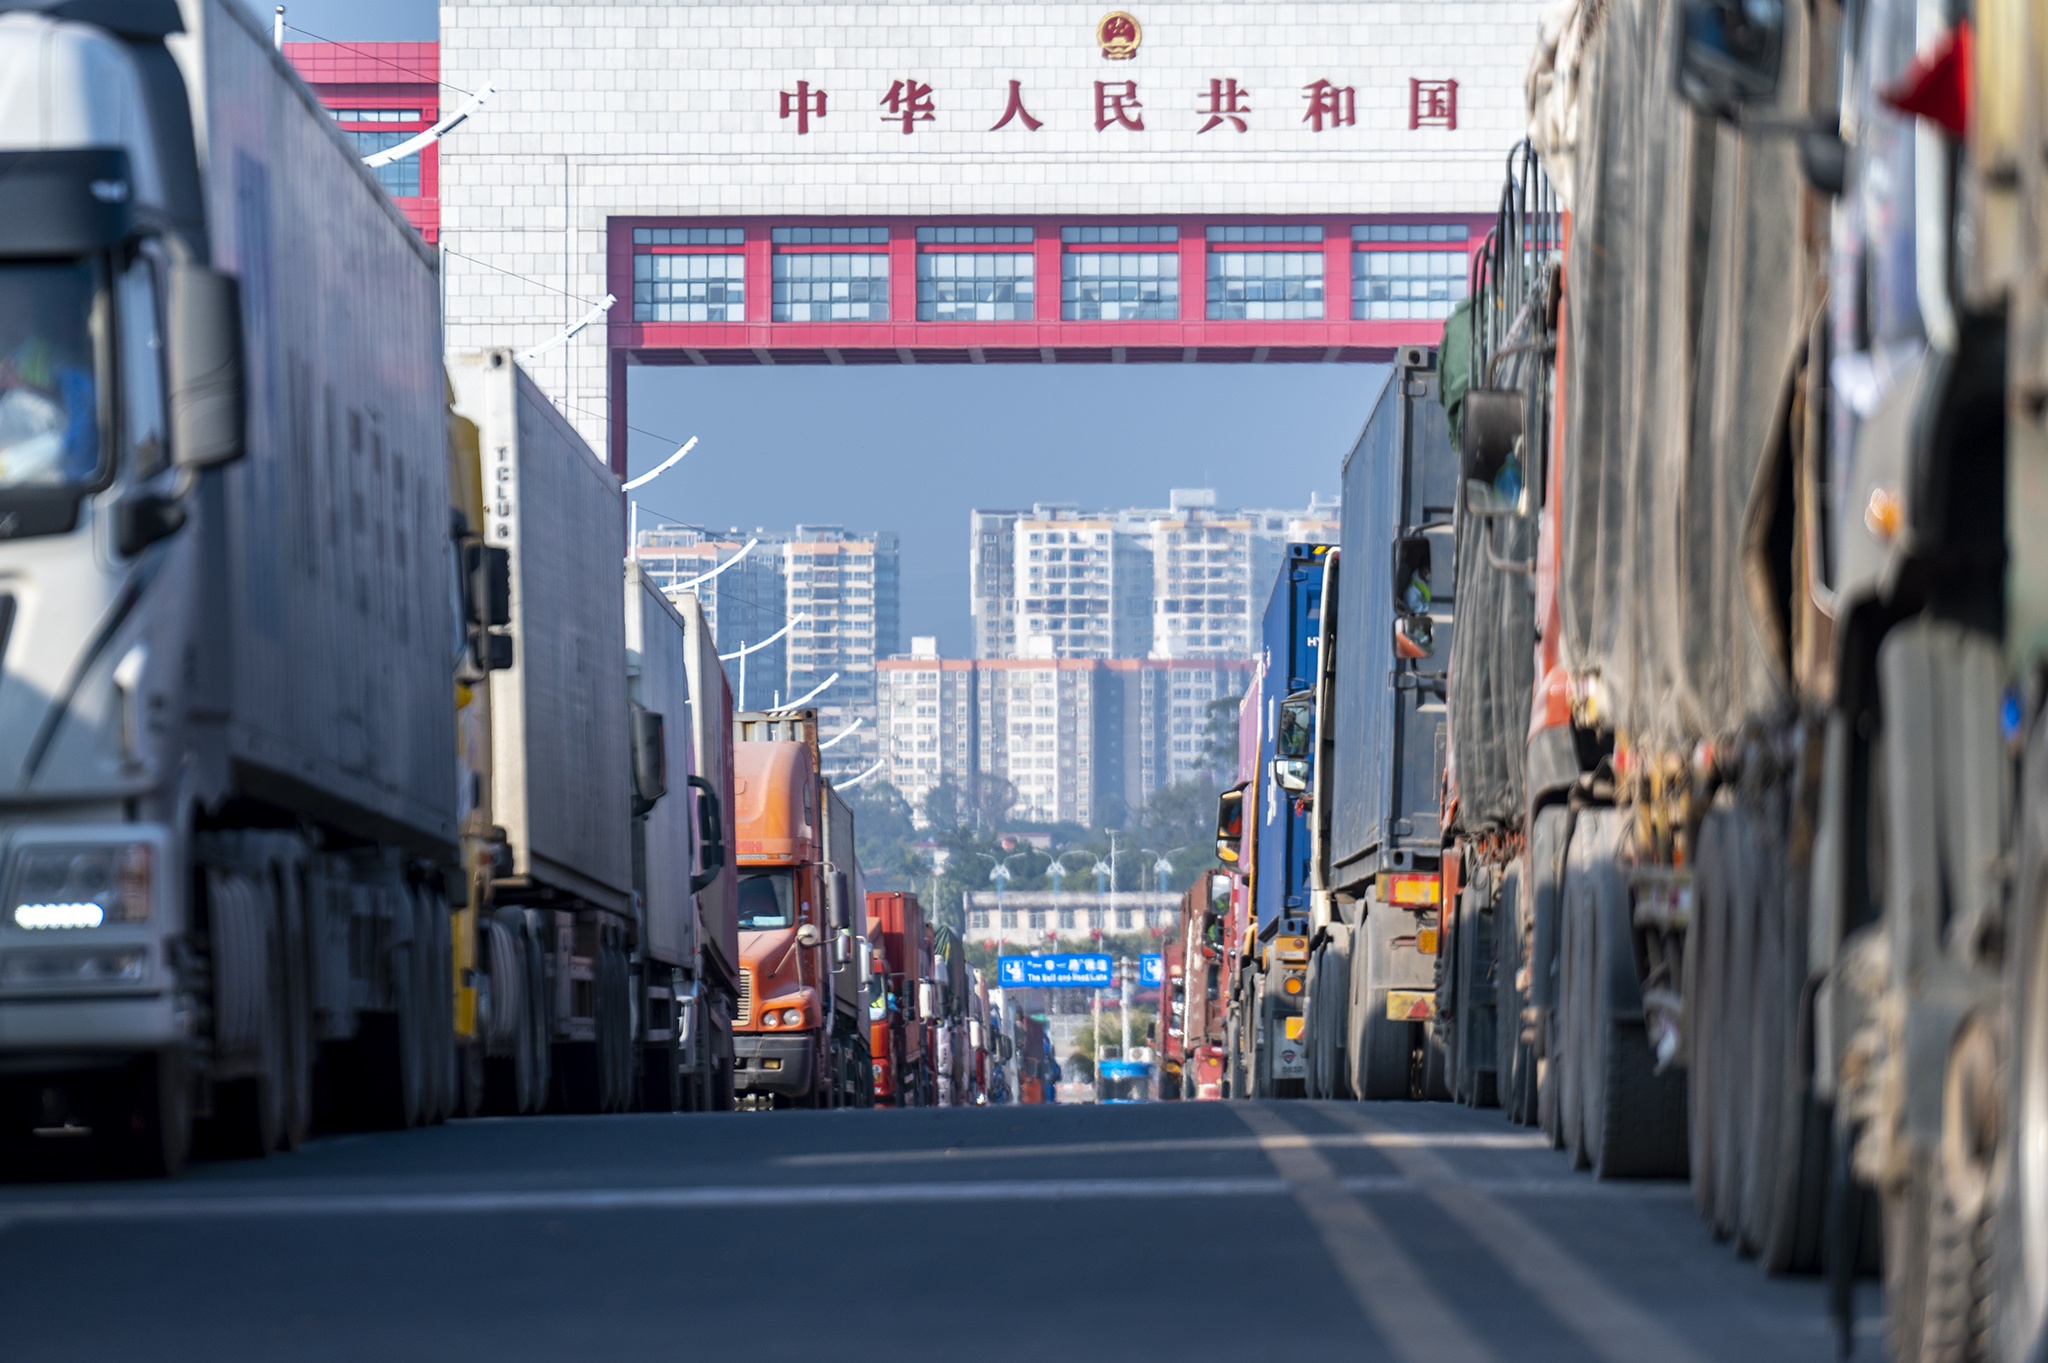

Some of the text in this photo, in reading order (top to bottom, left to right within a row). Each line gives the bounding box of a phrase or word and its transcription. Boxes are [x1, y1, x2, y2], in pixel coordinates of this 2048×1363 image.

[779, 77, 1460, 135] 中华人民共和国
